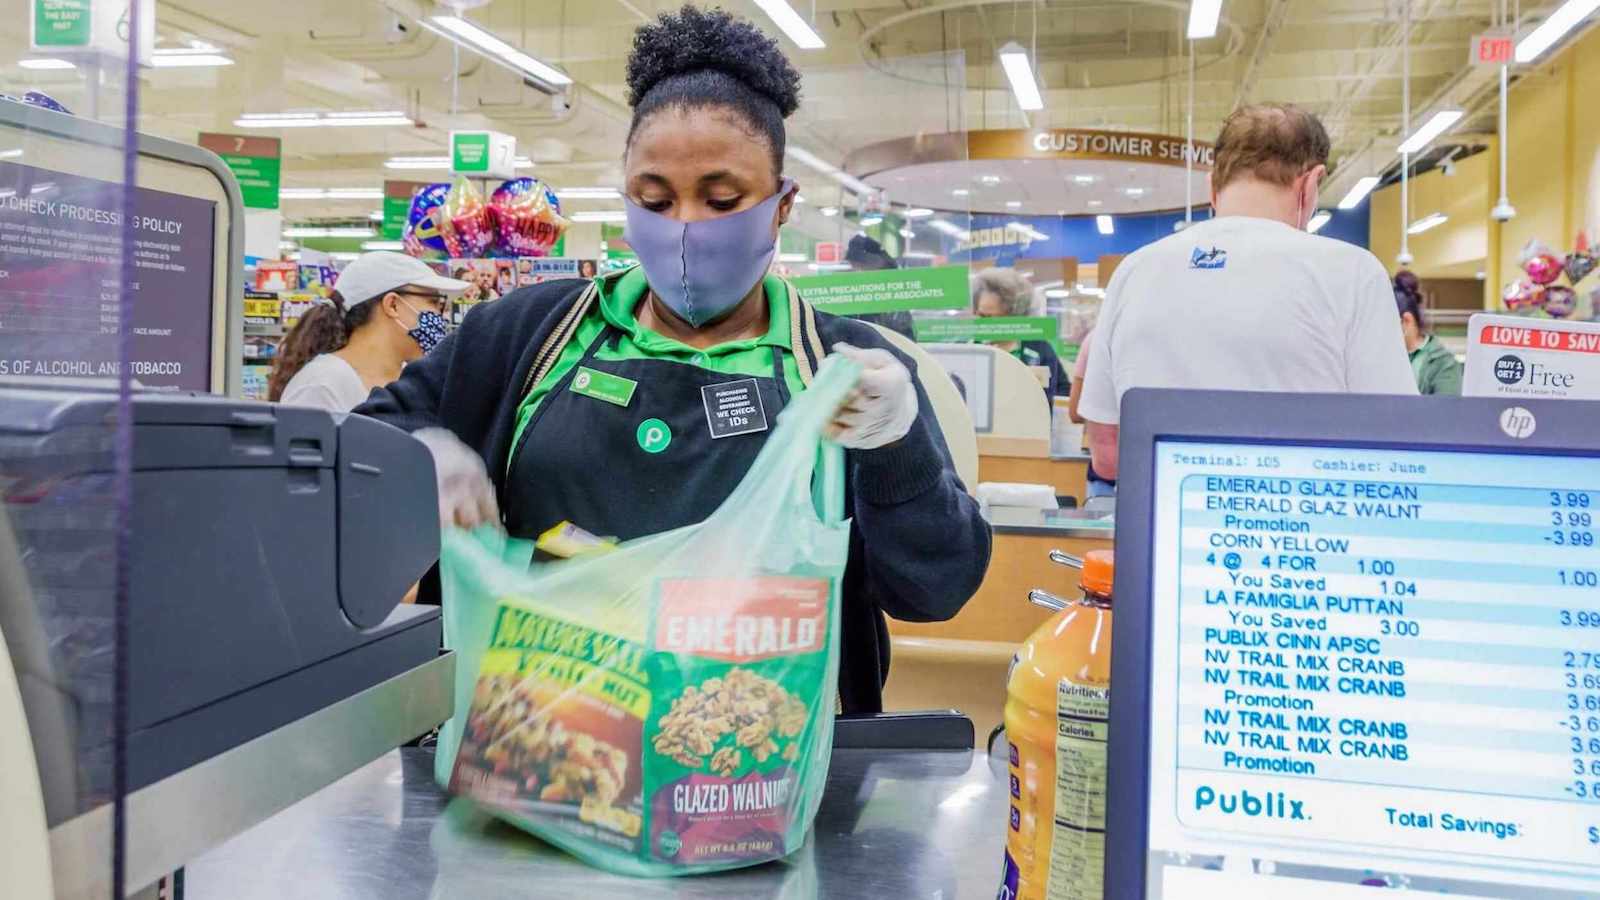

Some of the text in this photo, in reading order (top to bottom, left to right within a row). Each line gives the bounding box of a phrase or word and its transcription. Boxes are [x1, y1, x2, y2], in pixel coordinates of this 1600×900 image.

[1479, 38, 1513, 63] EXIT
[500, 144, 508, 167] 7
[1034, 132, 1215, 166] CUSTOMER SERVIC
[9, 196, 56, 217] CHECK
[60, 203, 139, 229] PROCESSIG
[142, 216, 182, 235] POLICY
[803, 280, 922, 297] EXTRA PRECAUTIONS FOR THE
[855, 294, 872, 303] AND
[875, 292, 892, 300] OUR
[1492, 327, 1531, 345] LOVE
[1541, 331, 1560, 347] TO
[13, 360, 31, 374] OF
[35, 360, 94, 375] ALCOHOL
[130, 361, 181, 375] TOBACCO
[1497, 360, 1515, 369] BUY
[1497, 370, 1521, 379] GET 1
[1529, 363, 1575, 388] Free
[720, 394, 747, 403] ALCOHOLIC
[716, 406, 756, 418] WE CHECK
[729, 416, 749, 427] IDs
[1506, 408, 1532, 438] hp
[1173, 453, 1248, 468] Terminal:
[1313, 459, 1427, 474] Cashier: June
[1207, 477, 1418, 500] EMERALD GLAZ PECAN
[1550, 491, 1590, 508] 3.99
[1207, 496, 1421, 519] EMERALD GLAZ WALNT
[1551, 511, 1591, 527] 3.99
[1225, 514, 1310, 533] Promotion
[1210, 533, 1349, 553] CORN YELLOW
[1543, 530, 1593, 546] -3.99
[1206, 552, 1395, 575] 4 @ 4 FOR 1.00
[1228, 571, 1417, 596] You Saved 1.04
[1558, 571, 1598, 587] 1.00
[1205, 590, 1404, 615] LA FAMIGLIA PUTTAN
[1228, 610, 1420, 637] You Saved 3.00
[1560, 611, 1600, 627] 3.99
[668, 615, 817, 656] EMERALD
[1205, 628, 1381, 654] PUBLIX CINN APSC
[1205, 649, 1405, 676] NV TRAIL MIX CRANB
[602, 680, 641, 708] NUT
[1205, 669, 1406, 697] NV TRAIL MIX CRANB
[1225, 690, 1314, 711] Promotion
[1059, 723, 1094, 737] Calories
[1205, 709, 1408, 740] NV TRAIL MIX CRANB
[1205, 730, 1408, 761] NV TRAIL MIX CRANB
[1224, 751, 1315, 774] Promotion
[674, 783, 729, 814] GLAZED
[1385, 808, 1433, 830] Total
[1441, 813, 1523, 839] Savings:
